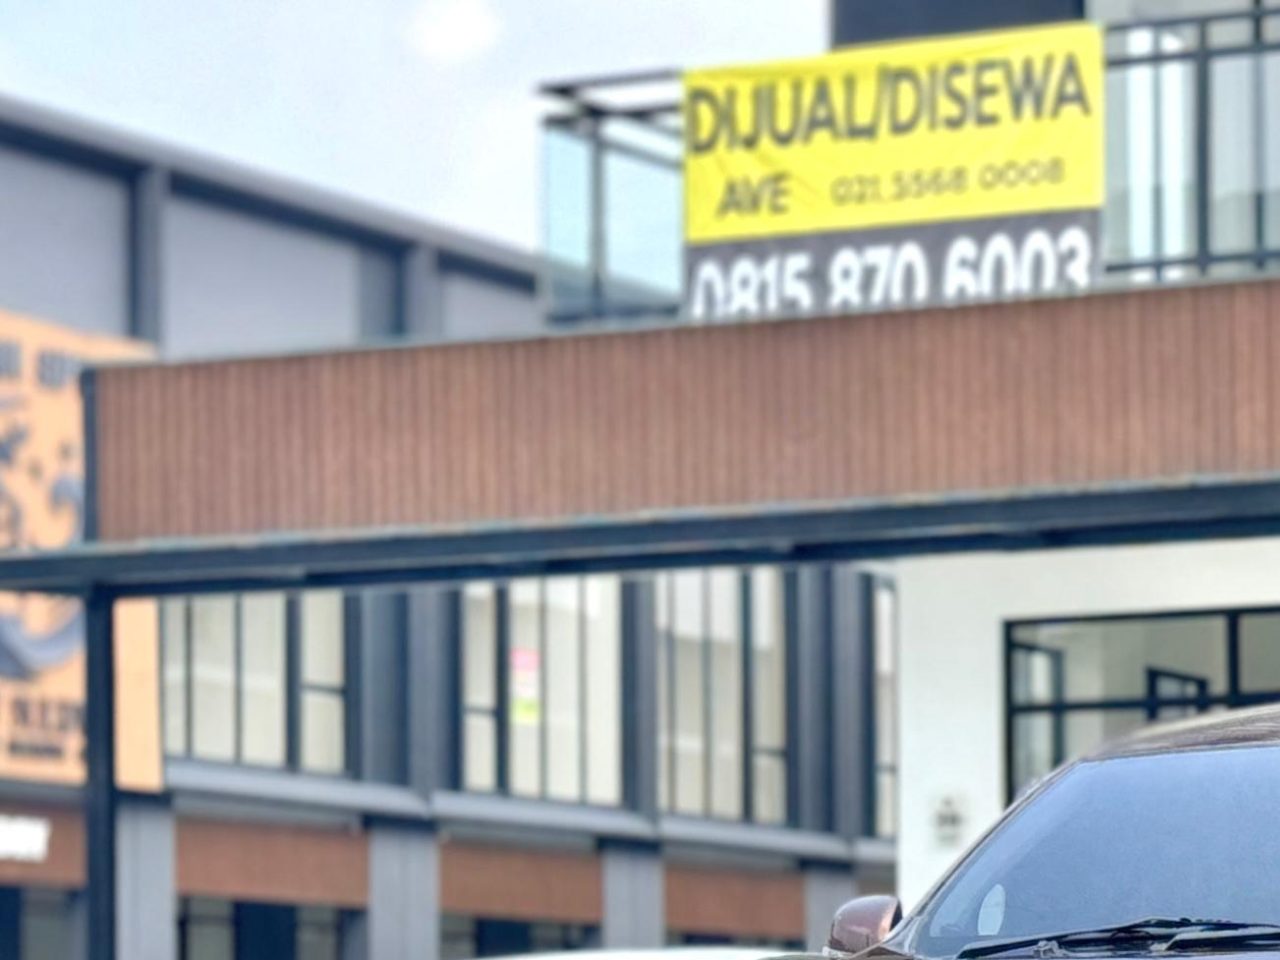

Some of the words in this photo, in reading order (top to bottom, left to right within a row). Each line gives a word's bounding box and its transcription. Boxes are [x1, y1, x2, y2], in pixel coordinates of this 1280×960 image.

[687, 52, 1092, 156] DIJUAL/DISEWA
[716, 172, 791, 218] AVE
[828, 242, 928, 309] 870
